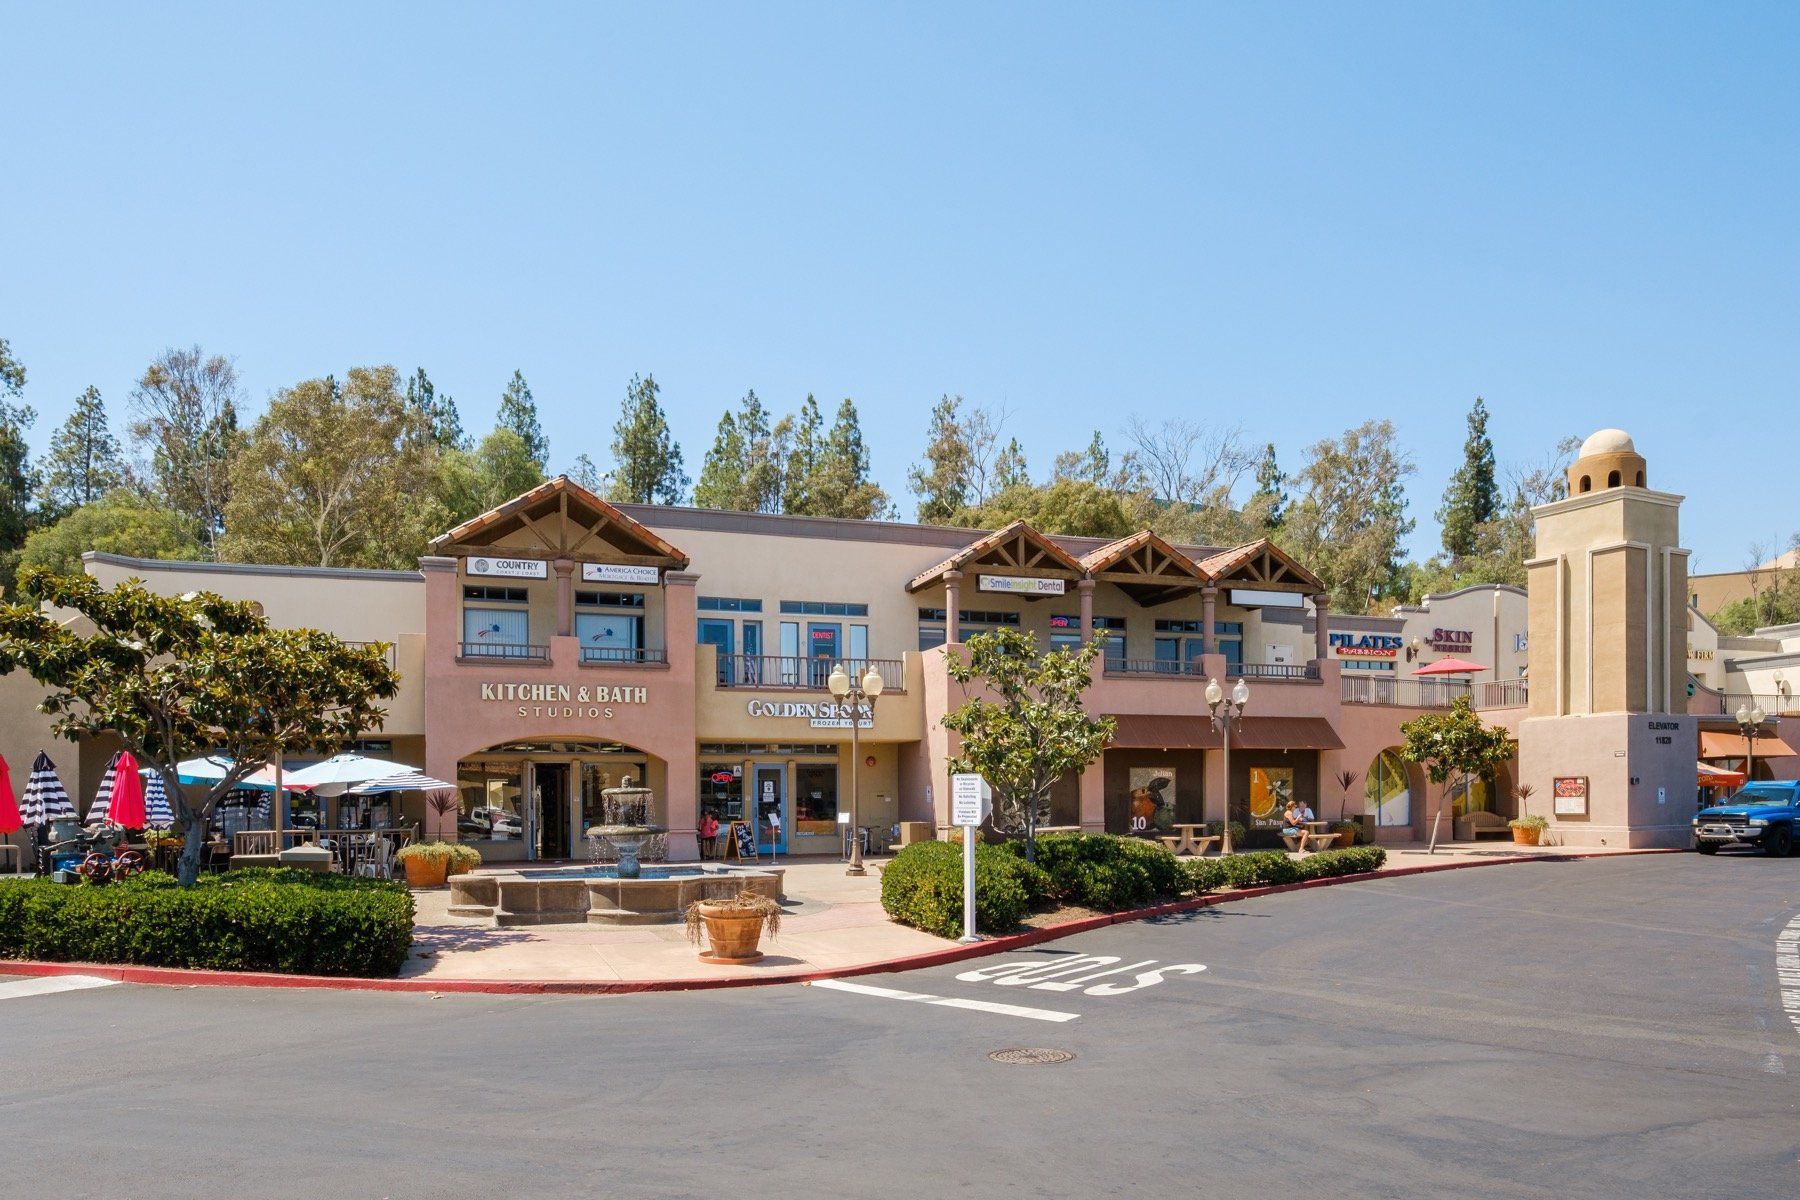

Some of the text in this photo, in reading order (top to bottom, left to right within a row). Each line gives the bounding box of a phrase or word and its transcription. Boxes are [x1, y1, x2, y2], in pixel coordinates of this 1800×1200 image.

[496, 560, 539, 570] COUNTRY
[605, 566, 632, 574] AMERICA
[1038, 580, 1063, 591] Dental
[812, 631, 833, 639] DENTIST
[1433, 628, 1473, 643] SKIN
[1329, 633, 1403, 649] PILATES
[1424, 637, 1434, 647] by
[1340, 647, 1394, 656] PASSION
[1695, 650, 1715, 660] FIRM
[481, 683, 647, 704] KITCHEN & BATH
[518, 706, 613, 718] STUDIOS
[747, 700, 817, 718] GOLDEN
[1648, 721, 1680, 730] ELEVATOR
[712, 773, 733, 782] OPEN
[1253, 770, 1259, 783] 1
[1132, 816, 1146, 830] 10
[1269, 819, 1284, 828] Pasq
[955, 953, 1208, 996] STOP
